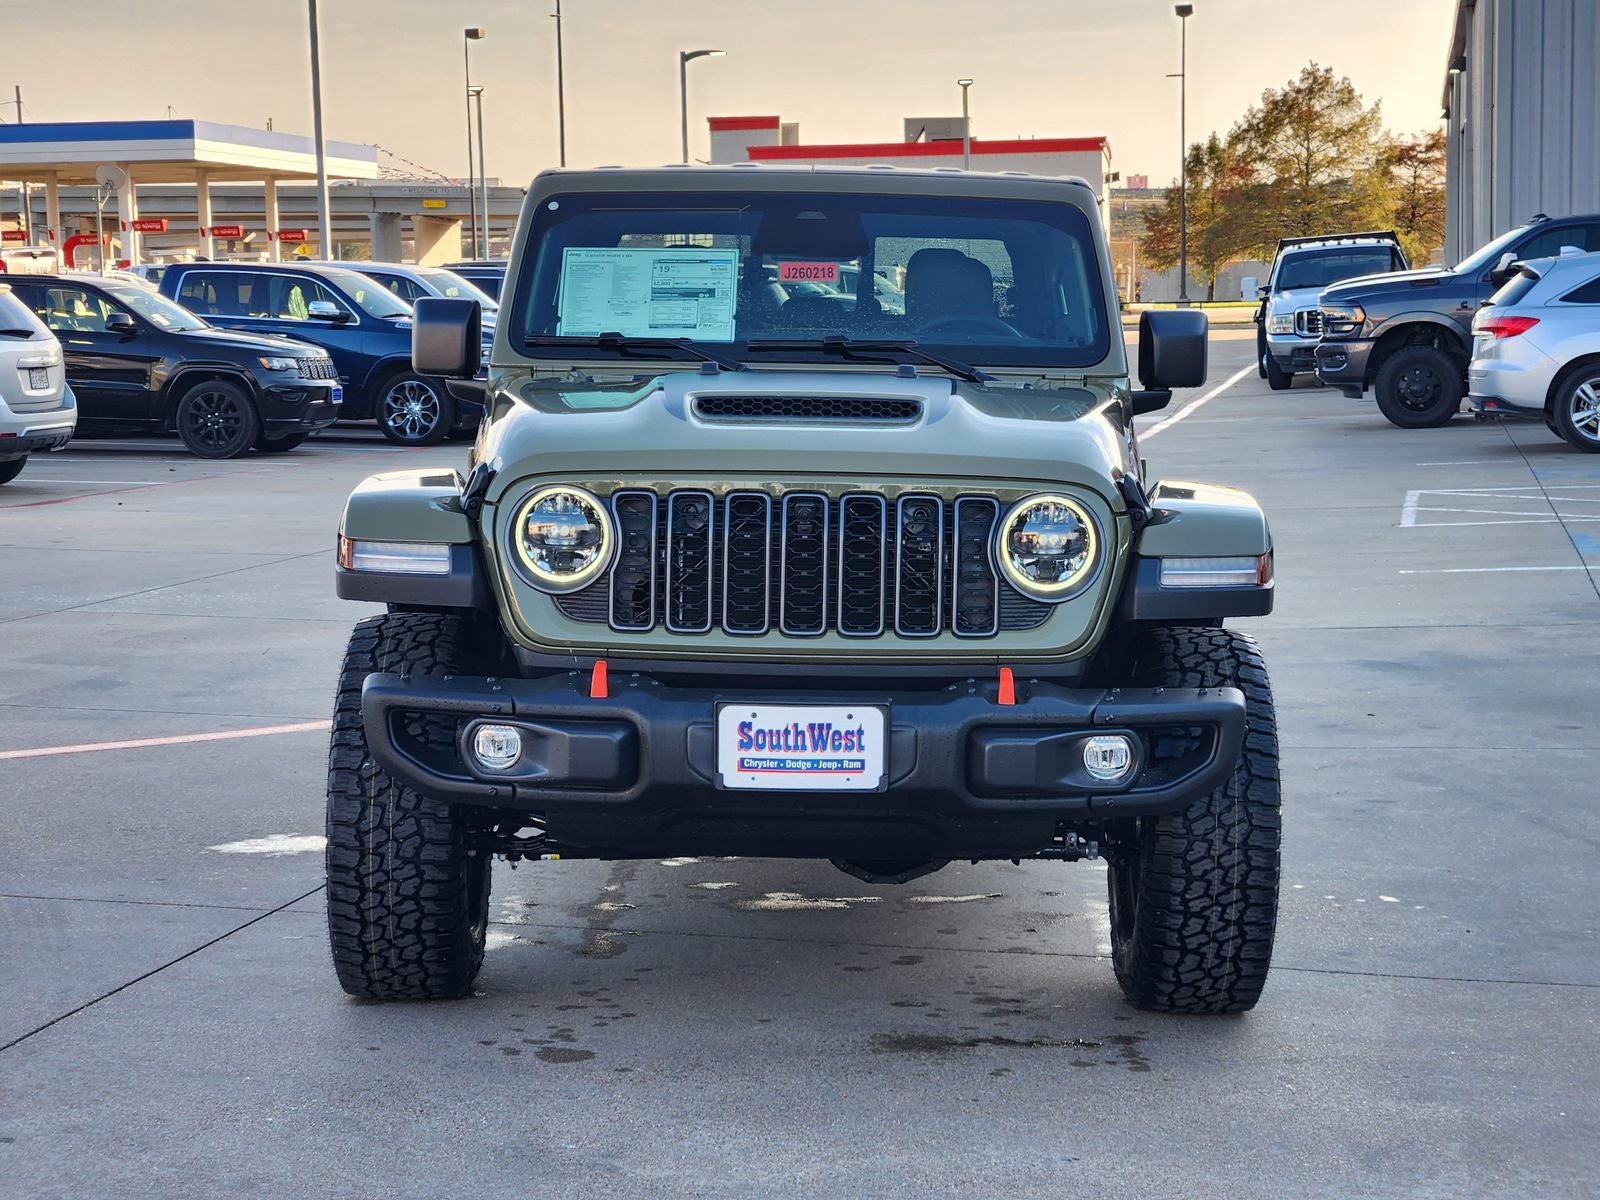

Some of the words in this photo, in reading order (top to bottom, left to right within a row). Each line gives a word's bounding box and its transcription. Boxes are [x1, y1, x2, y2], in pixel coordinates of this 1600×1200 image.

[659, 265, 670, 273] 19
[784, 266, 834, 279] J260218
[737, 720, 866, 753] SouthWest
[743, 758, 778, 769] Chrysler
[785, 759, 812, 769] Dodge
[818, 760, 837, 770] Jeep
[842, 761, 861, 769] Ram
